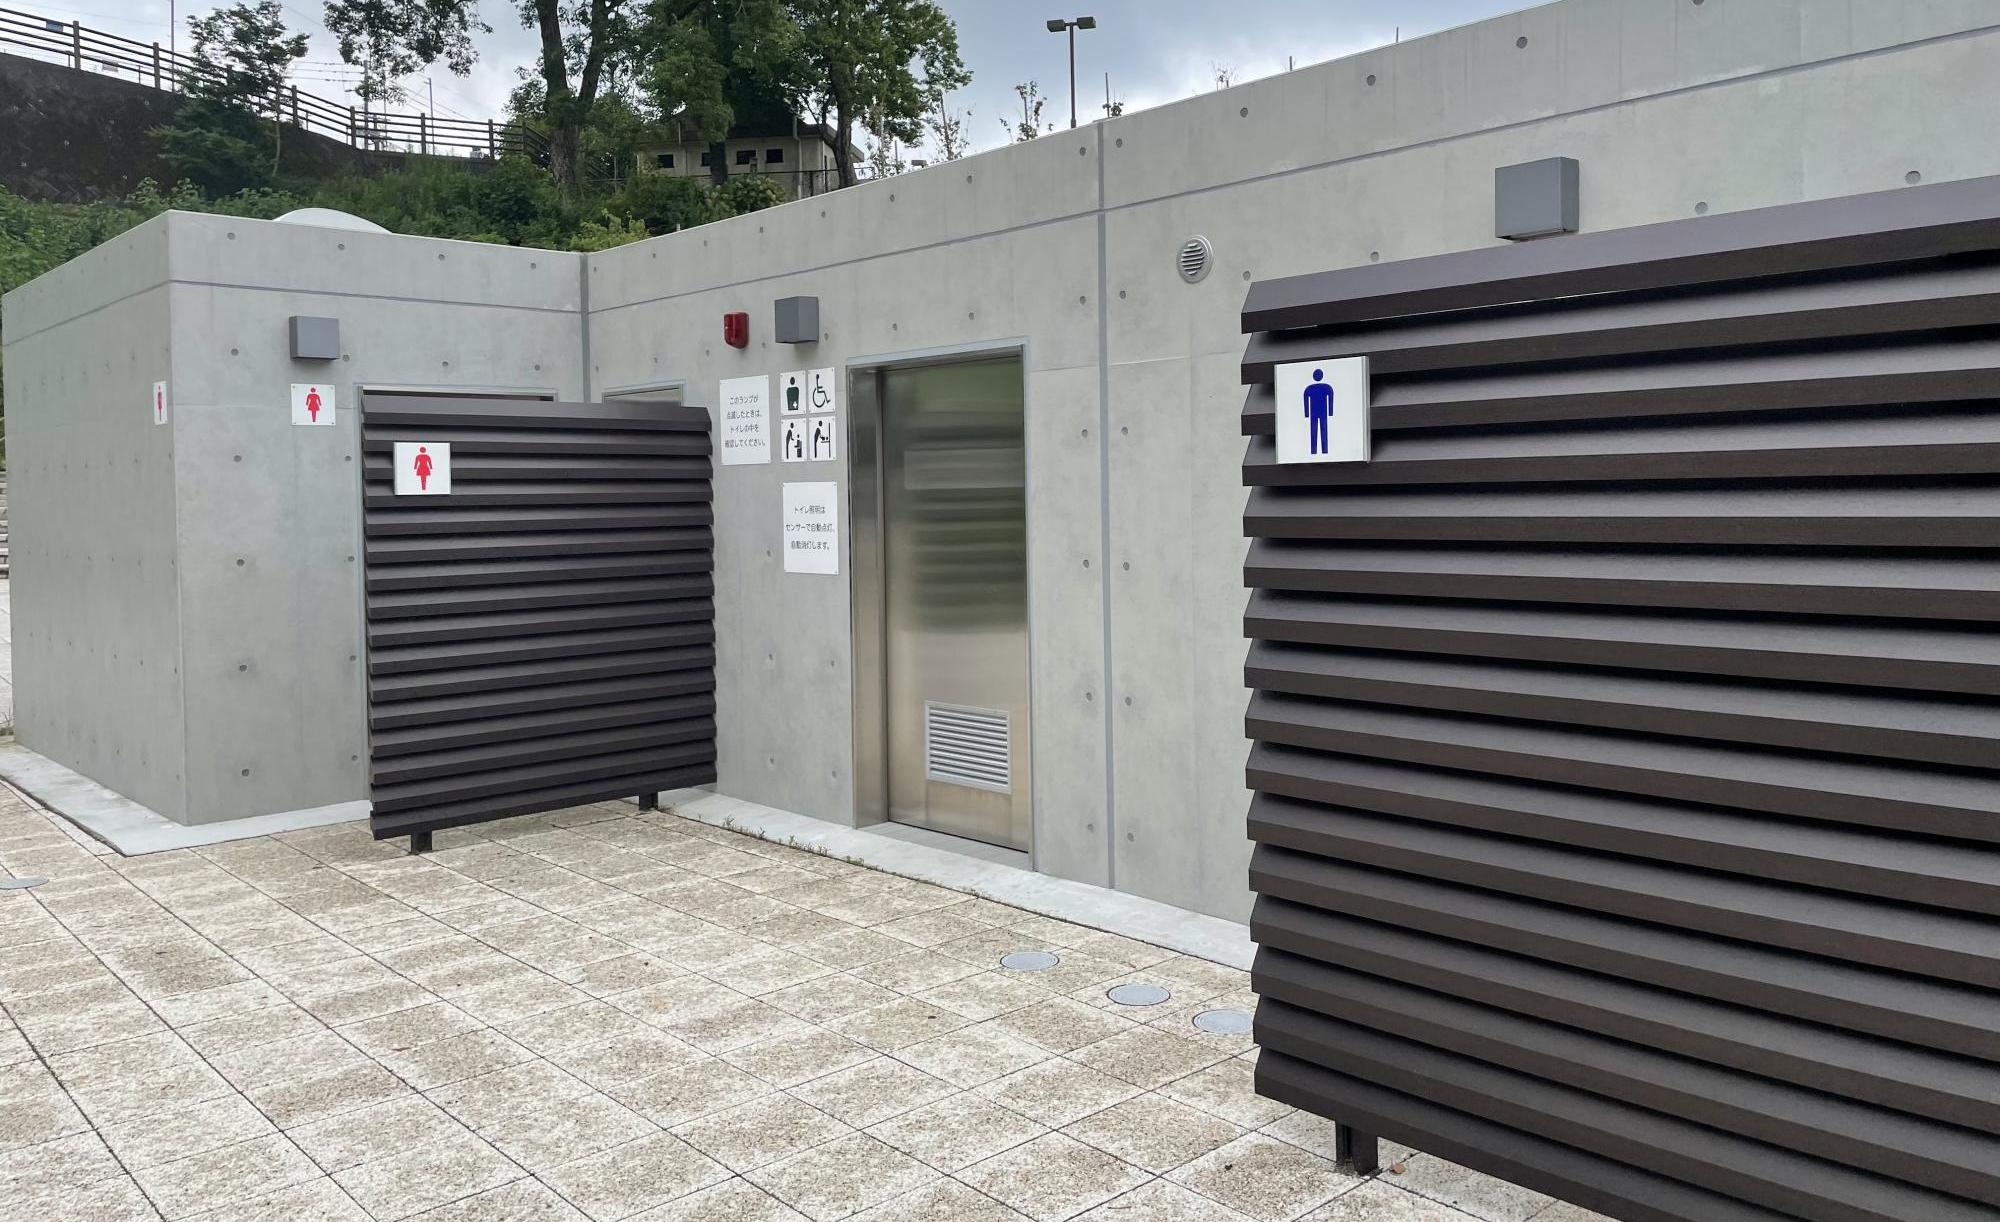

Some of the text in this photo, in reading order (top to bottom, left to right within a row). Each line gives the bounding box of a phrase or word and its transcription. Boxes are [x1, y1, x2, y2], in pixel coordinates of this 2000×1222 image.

[729, 395, 759, 404] このランプが
